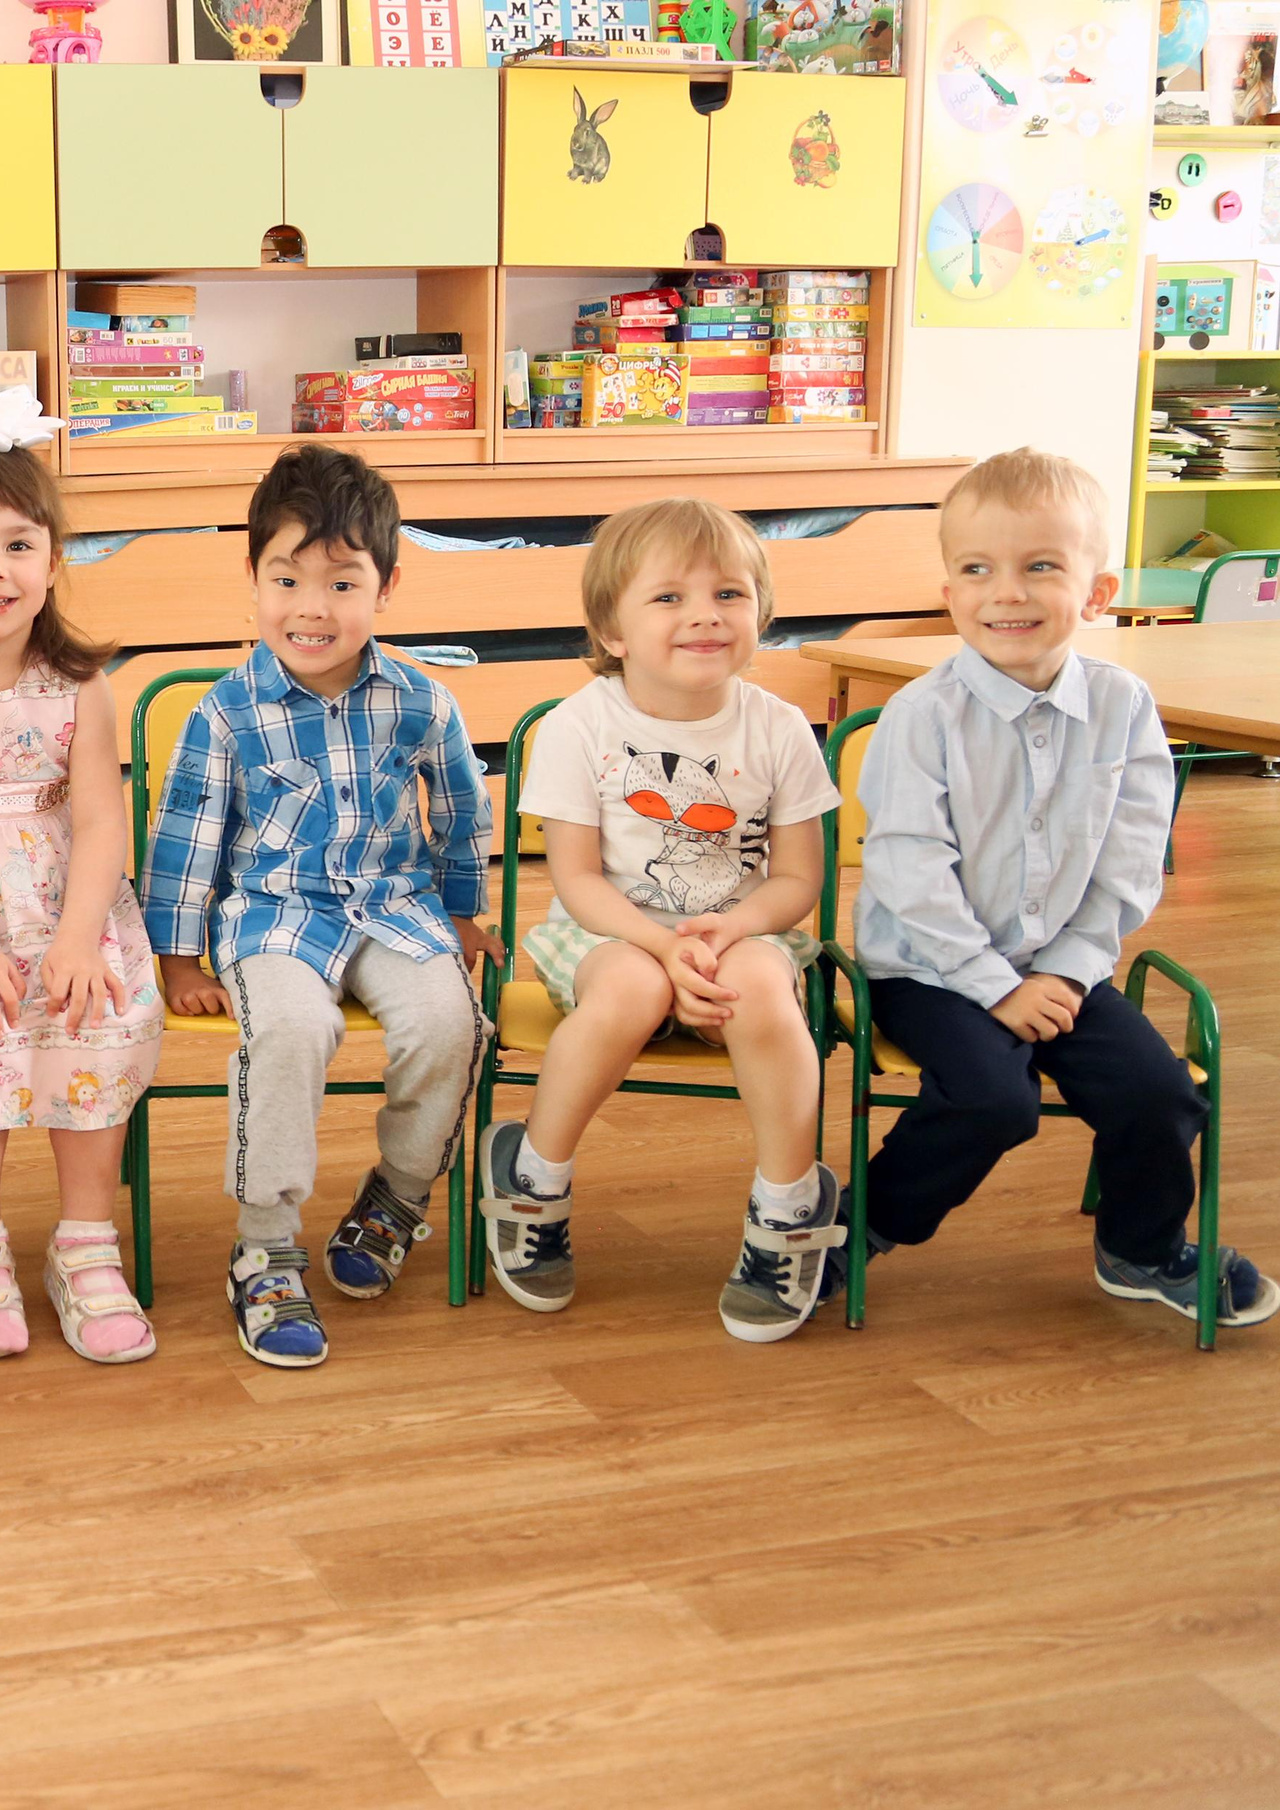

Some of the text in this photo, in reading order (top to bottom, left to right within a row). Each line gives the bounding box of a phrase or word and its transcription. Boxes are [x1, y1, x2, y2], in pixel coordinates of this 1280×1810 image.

[511, 2, 526, 17] М
[606, 5, 619, 19] Х
[386, 11, 401, 26] О
[429, 9, 443, 27] Ё
[490, 13, 504, 28] Л
[542, 12, 554, 26] Г
[577, 14, 592, 28] К
[513, 25, 527, 39] Н
[388, 36, 402, 50] Э
[431, 36, 445, 51] Е
[491, 34, 505, 52] Й
[626, 46, 671, 56] ПАЗЛ 500
[0, 356, 28, 380] СА
[112, 384, 175, 393] ИГРАЕМ И УЧИМСЯ
[380, 375, 417, 397] СЫРНАЯ
[416, 374, 448, 386] БАШНЯ
[600, 402, 626, 418] 50
